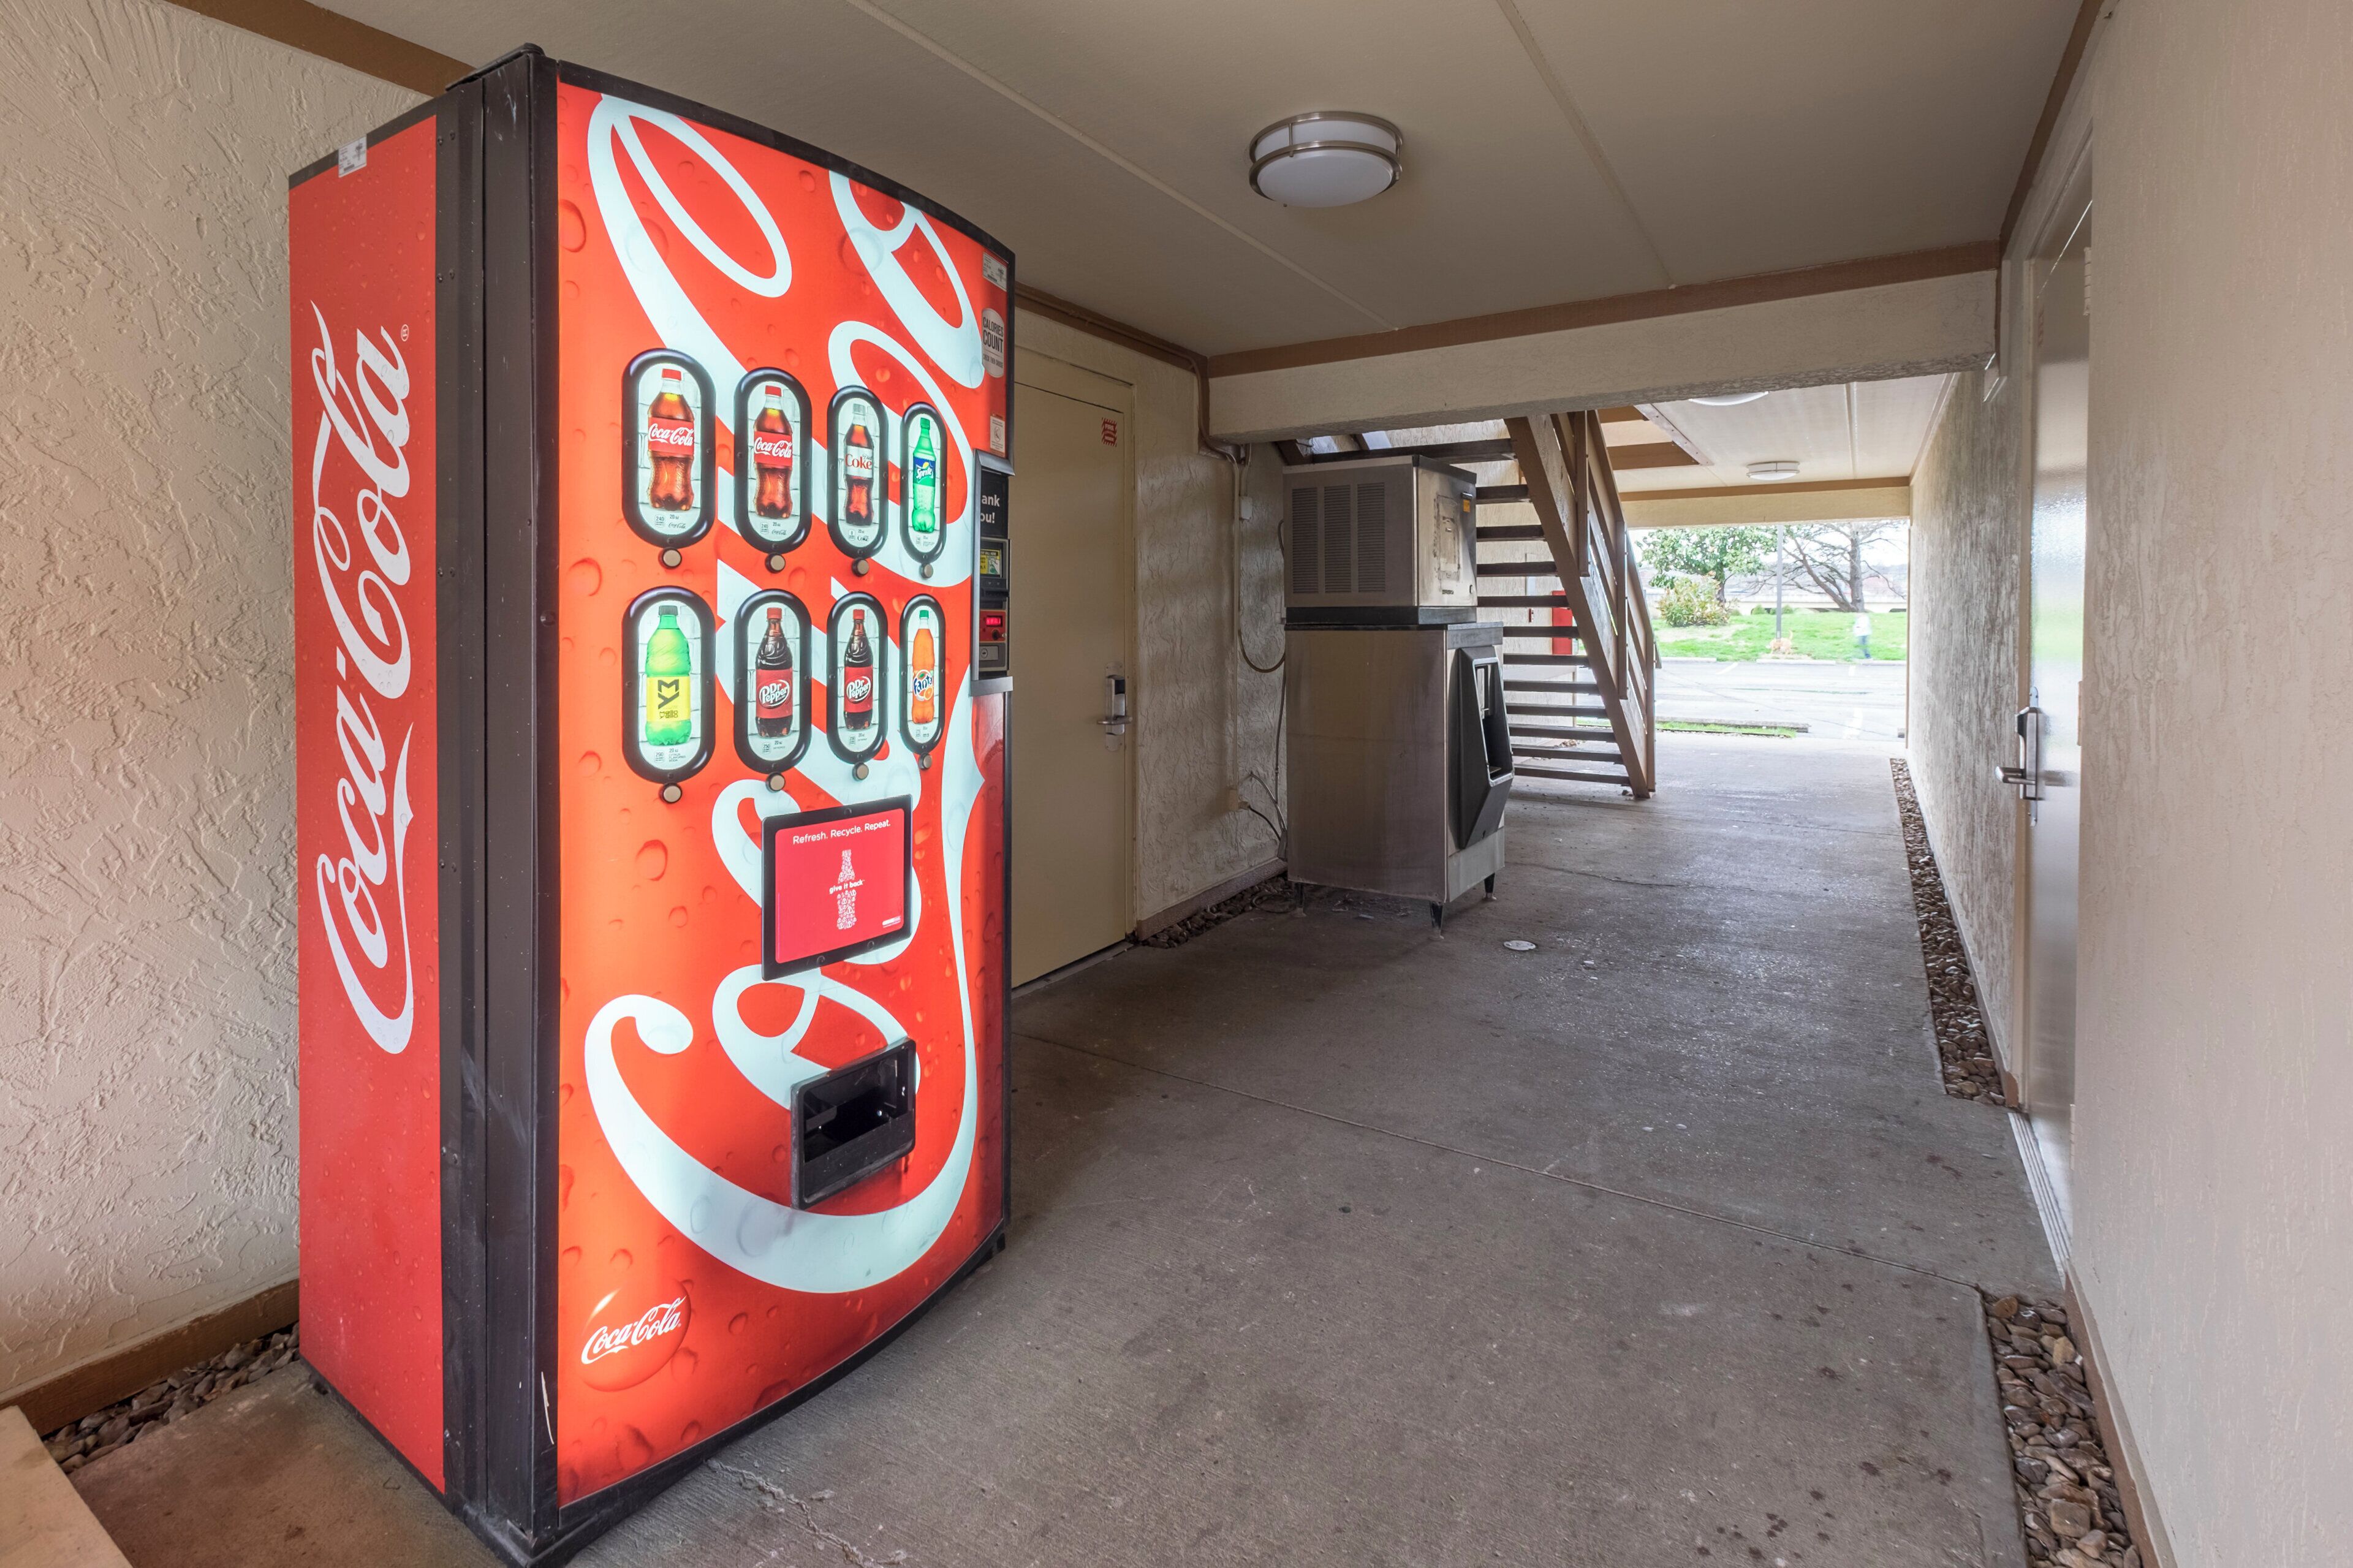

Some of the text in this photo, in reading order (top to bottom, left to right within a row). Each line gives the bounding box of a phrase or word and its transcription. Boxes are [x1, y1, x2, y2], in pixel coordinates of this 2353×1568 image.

[983, 317, 1003, 337] CALORIES
[983, 330, 1003, 353] COUNT
[648, 423, 694, 446] Coca-Cola
[754, 437, 793, 458] Coca-Cola
[846, 453, 873, 469] Coke
[915, 466, 932, 479] Sprite
[981, 494, 1000, 507] ank
[980, 512, 995, 523] ou!
[311, 300, 414, 1054] Coca-Cola
[854, 679, 865, 689] Dr
[762, 686, 789, 704] Pepper
[769, 683, 782, 694] Dr
[848, 681, 870, 699] Pepper
[793, 819, 890, 844] Refresh. Recycle. Repeat.
[829, 885, 843, 894] give
[849, 879, 863, 888] back
[582, 1295, 687, 1364] Coca-Cola
